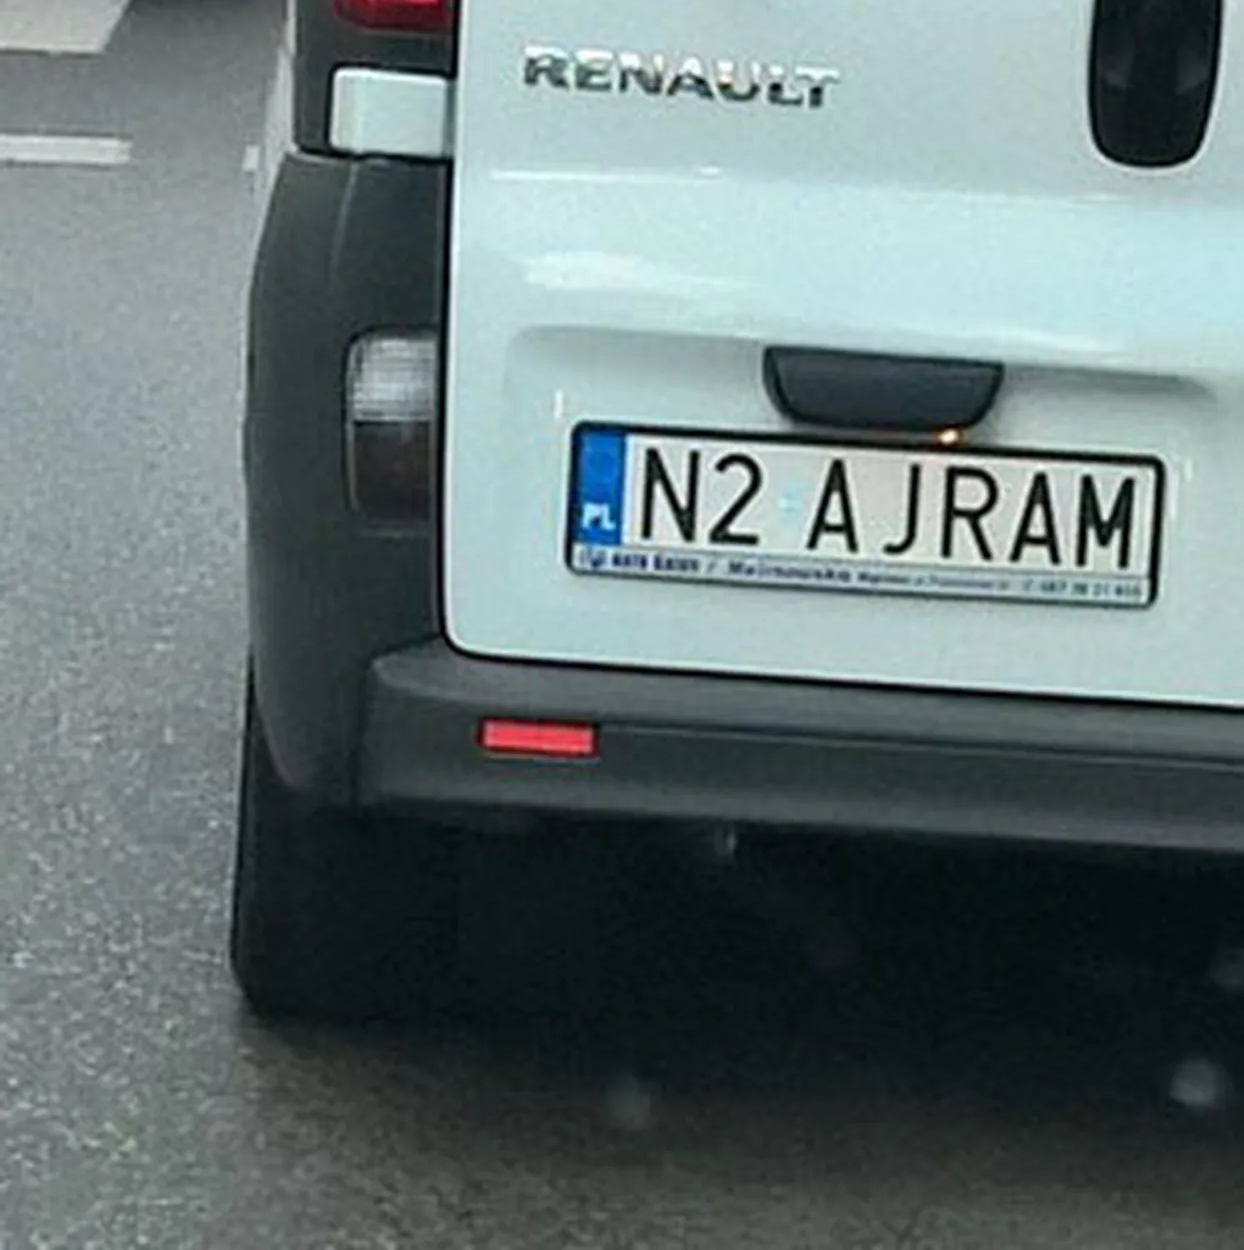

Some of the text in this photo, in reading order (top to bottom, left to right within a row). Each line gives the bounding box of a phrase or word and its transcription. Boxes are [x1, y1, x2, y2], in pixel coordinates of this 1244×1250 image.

[522, 45, 842, 109] RENAULT
[582, 502, 617, 531] PL
[640, 446, 1137, 570] N2 AJRAM
